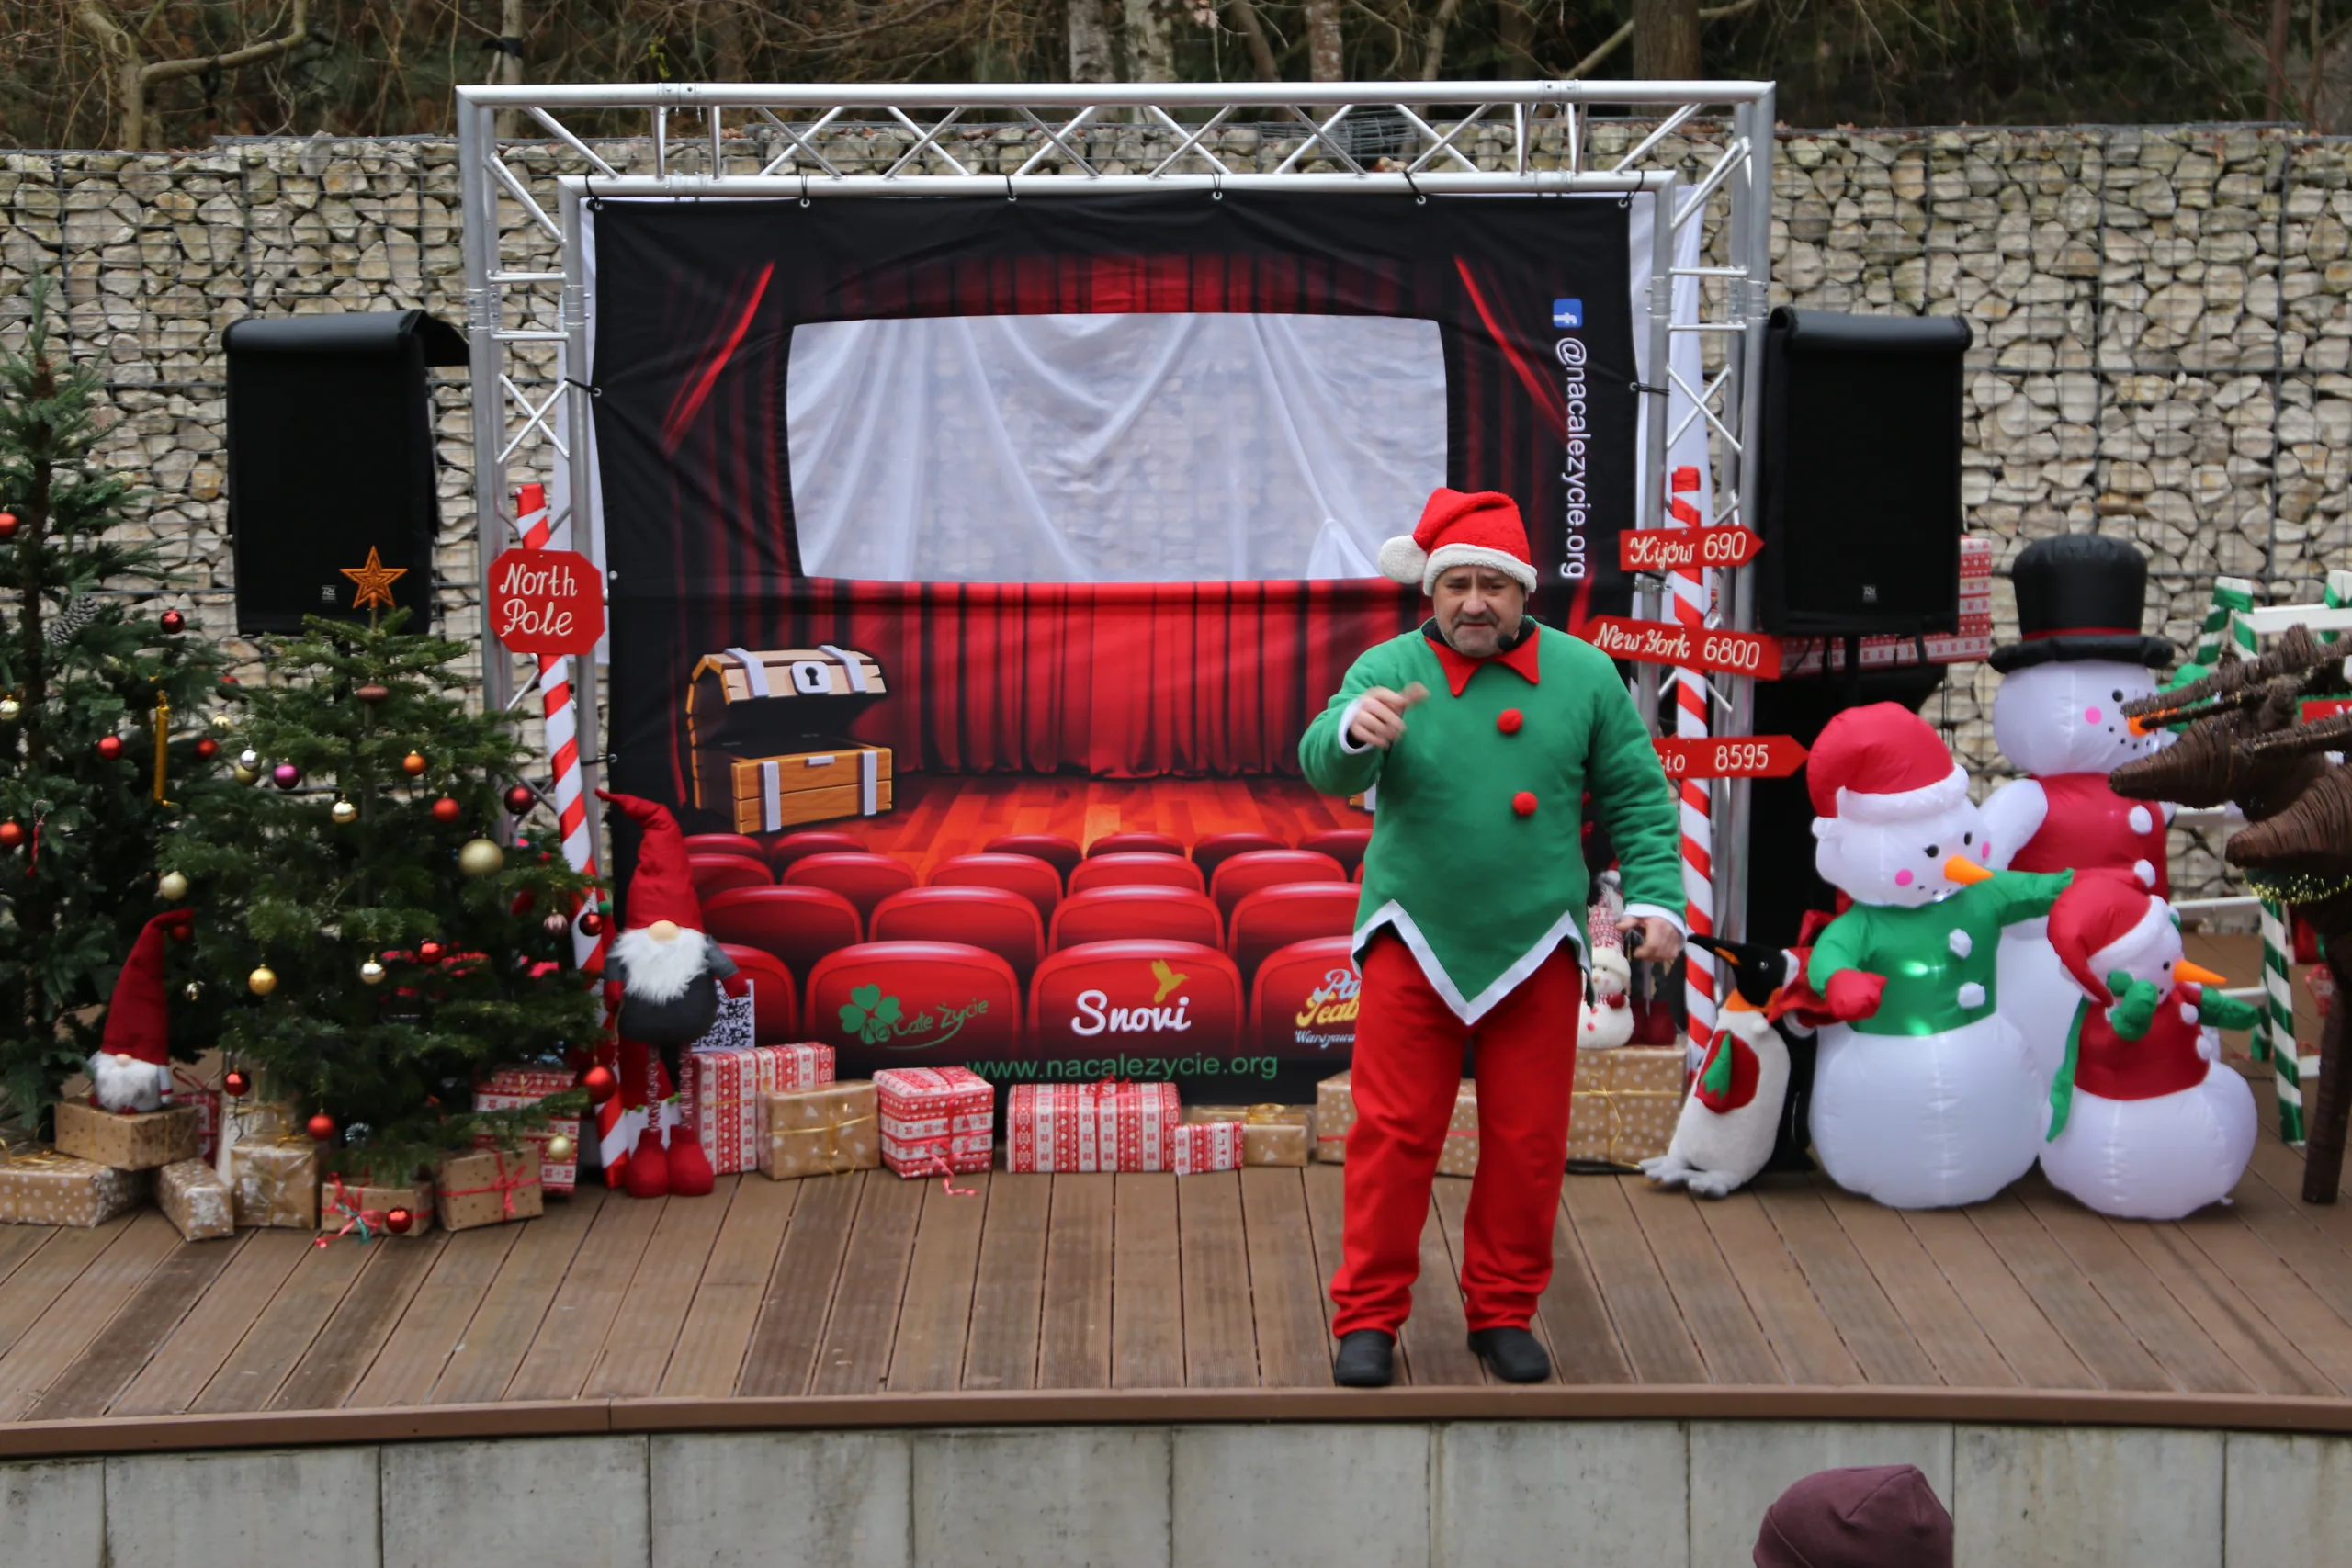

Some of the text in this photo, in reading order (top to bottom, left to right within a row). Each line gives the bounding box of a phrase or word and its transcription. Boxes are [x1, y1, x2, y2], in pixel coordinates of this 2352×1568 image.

[1555, 337, 1592, 580] @nacalezycie.org
[1629, 531, 1747, 569] Kijów 690
[499, 562, 578, 597] North
[500, 597, 574, 637] Pole
[1592, 621, 1761, 670] New York 6800
[1714, 742, 1770, 772] 8595
[1070, 989, 1192, 1036] Snovi
[966, 1052, 1278, 1081] www.nacalezycie.org
